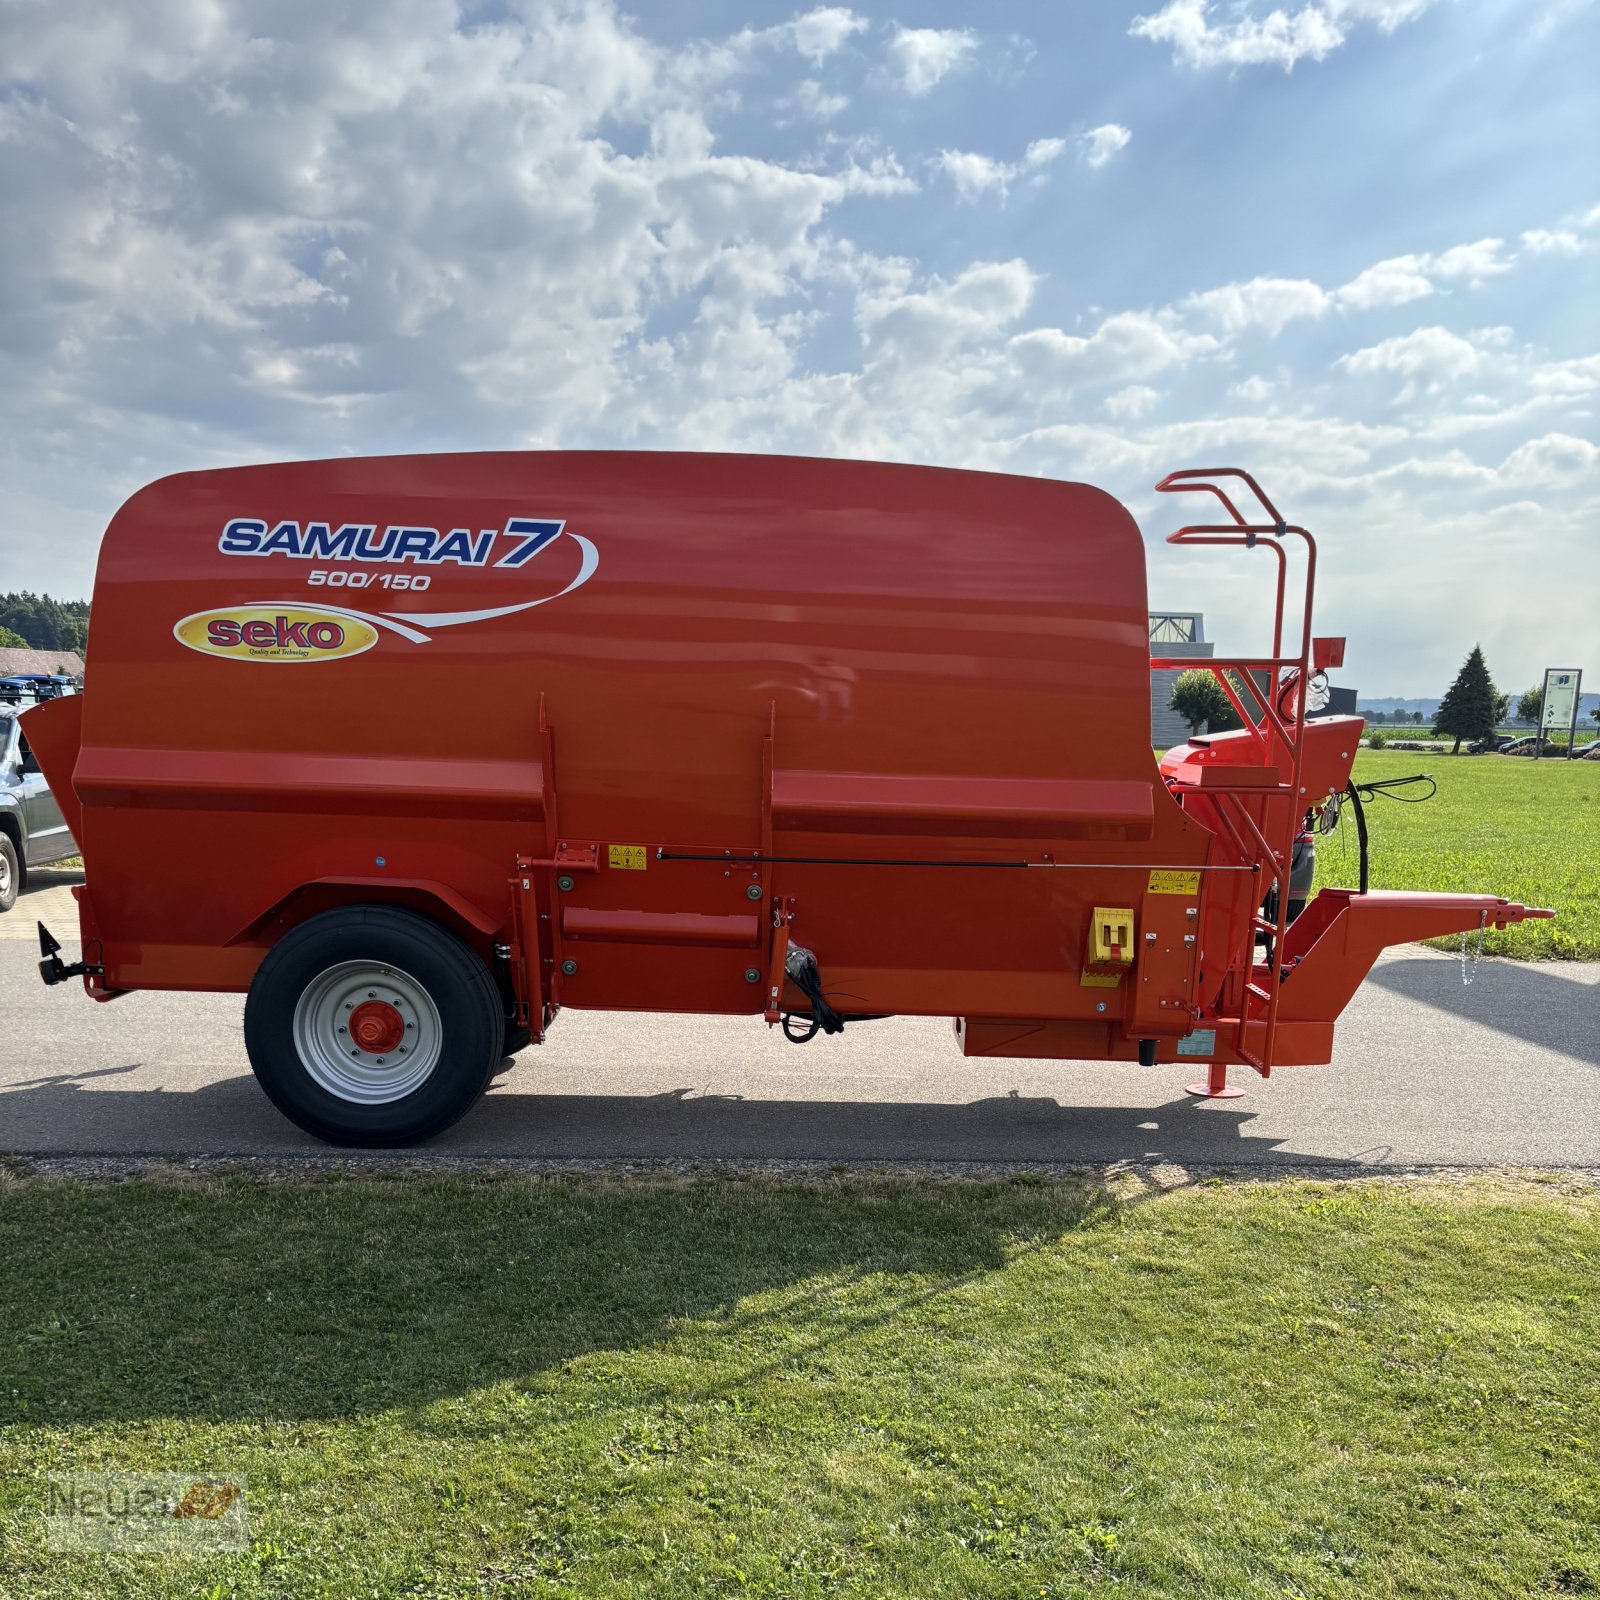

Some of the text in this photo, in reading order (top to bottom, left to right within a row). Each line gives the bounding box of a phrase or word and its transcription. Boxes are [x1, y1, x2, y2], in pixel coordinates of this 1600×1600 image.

[219, 518, 498, 566] SAMURAI
[308, 570, 431, 591] 500/150
[207, 616, 345, 648] seko
[249, 648, 269, 656] Quality
